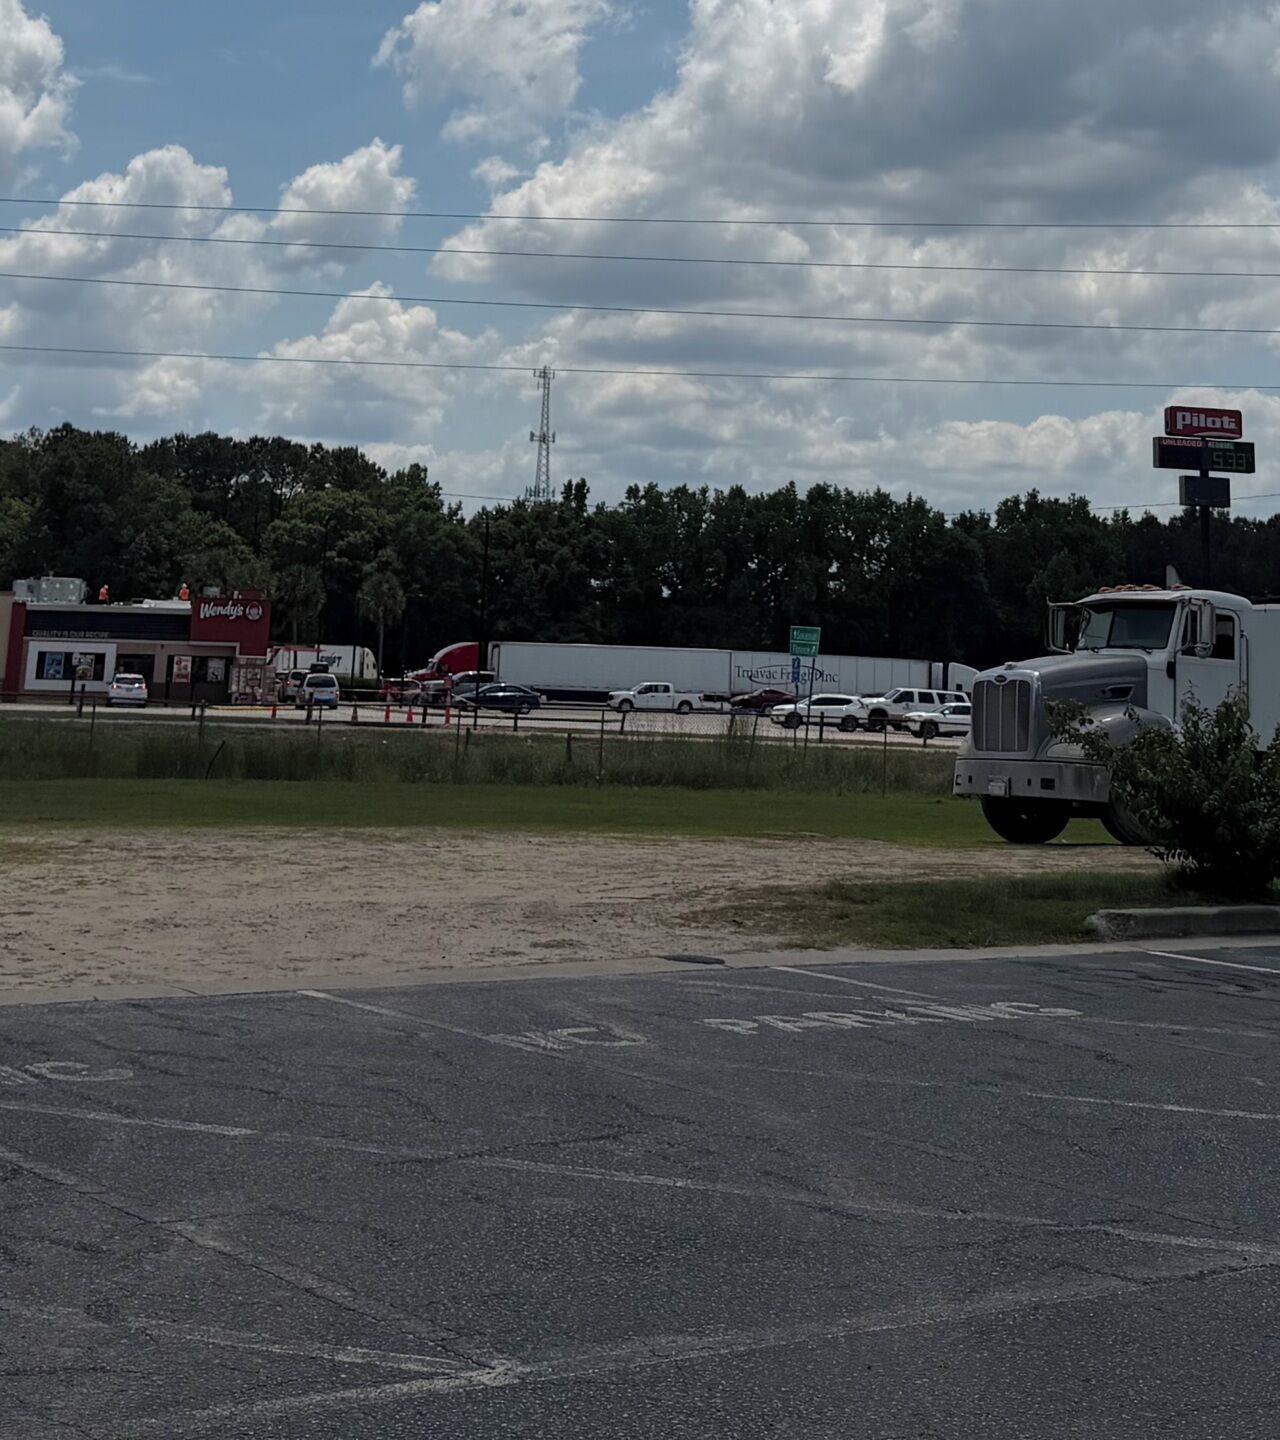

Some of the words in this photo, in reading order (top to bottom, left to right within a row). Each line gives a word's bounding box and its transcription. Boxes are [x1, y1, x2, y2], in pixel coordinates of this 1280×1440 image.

[1176, 411, 1237, 430] Pilot
[1162, 438, 1203, 448] UNLEADED
[200, 600, 245, 620] Wendy's
